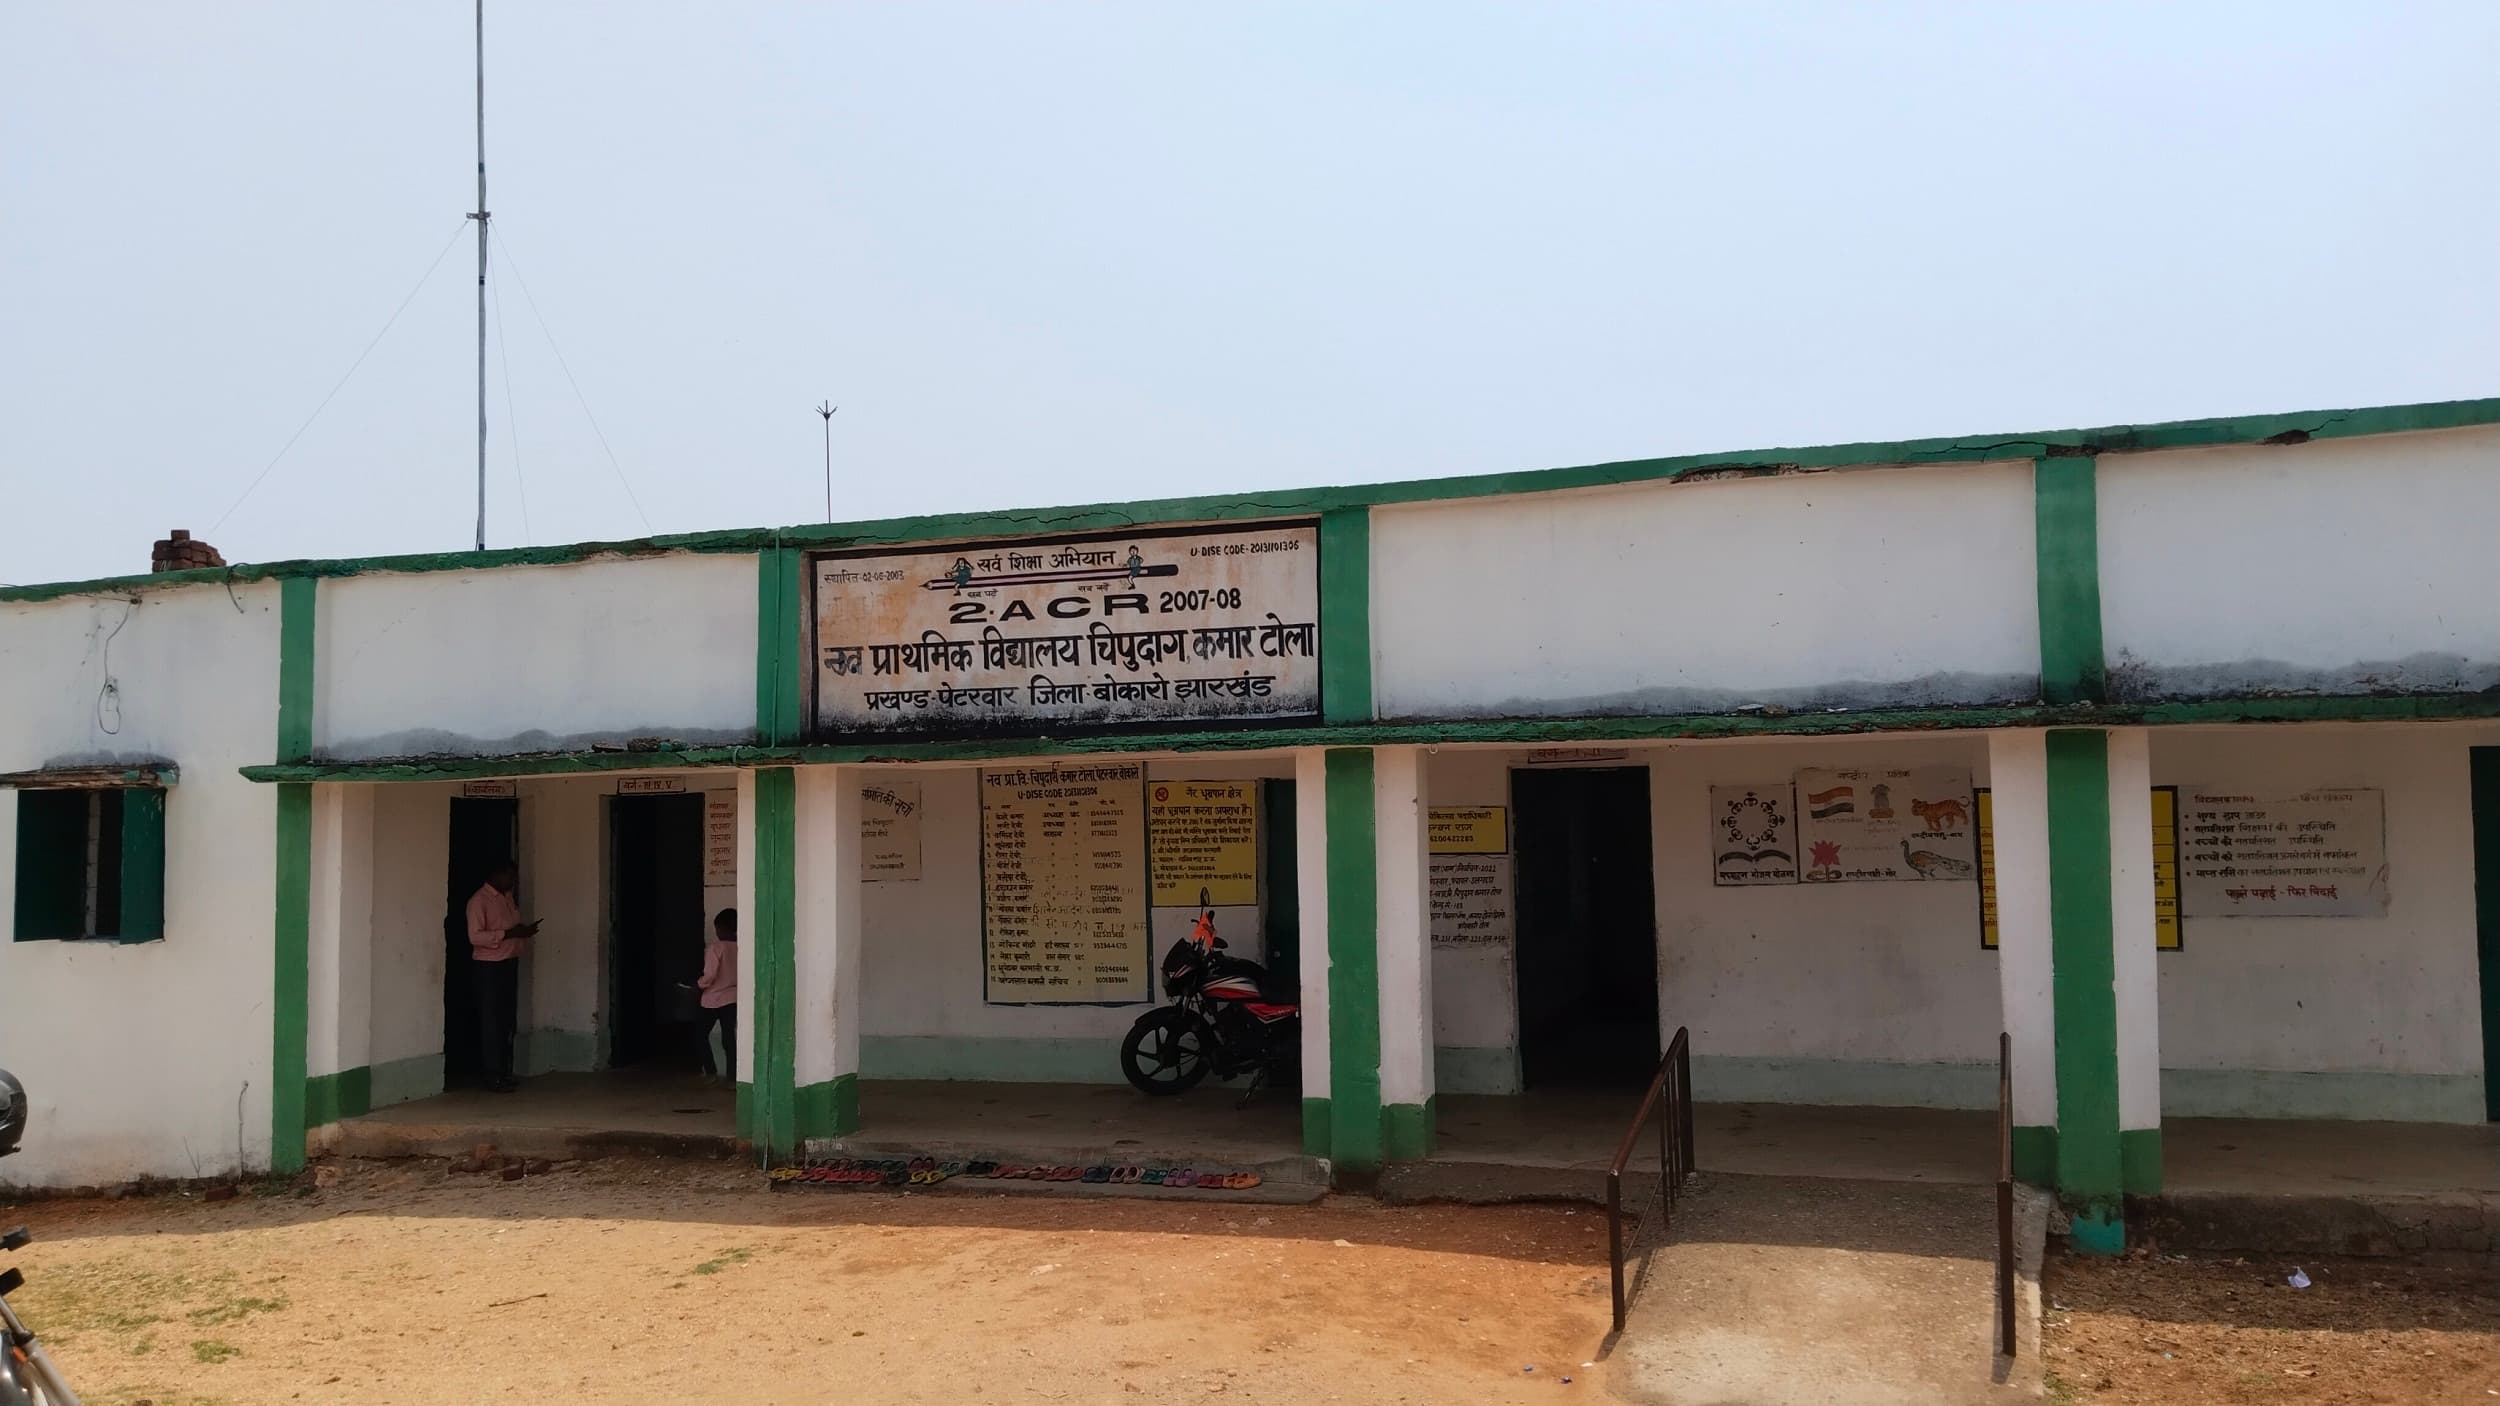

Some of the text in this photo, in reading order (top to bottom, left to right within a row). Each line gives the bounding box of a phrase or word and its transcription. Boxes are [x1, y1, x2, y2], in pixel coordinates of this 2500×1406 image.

[1008, 552, 1042, 571] शिक्षा
[1049, 547, 1116, 568] अभियान
[1160, 587, 1242, 613] 2007-08
[868, 629, 975, 677] प्राथमिक
[979, 625, 1084, 671] विद्यालय
[1192, 624, 1256, 662] कमार
[1256, 612, 1316, 658] टोला
[1174, 670, 1277, 704] झारखंड
[1044, 788, 1063, 799] CODE
[894, 798, 915, 818] सूची
[2287, 885, 2306, 897] फिर
